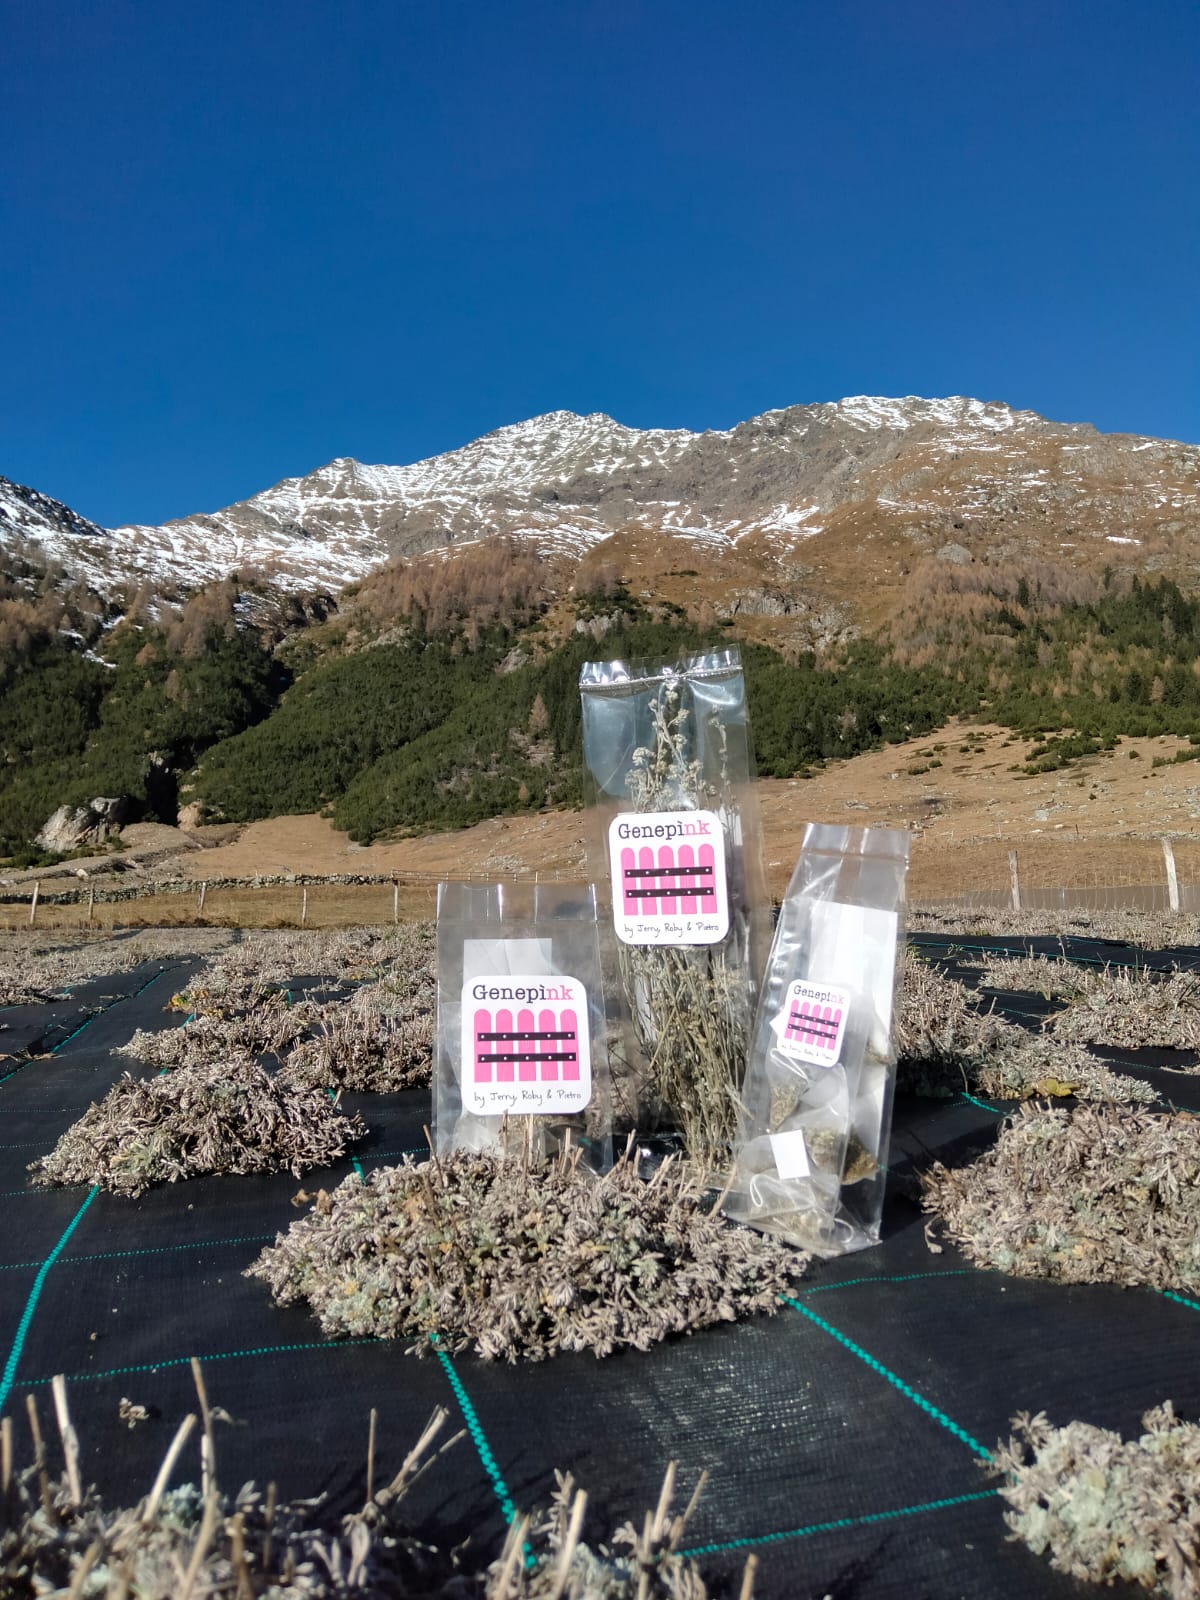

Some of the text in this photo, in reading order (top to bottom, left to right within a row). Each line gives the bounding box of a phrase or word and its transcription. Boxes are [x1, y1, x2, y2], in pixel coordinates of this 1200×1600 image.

[625, 924, 633, 938] by
[665, 922, 683, 937] Roby
[687, 922, 692, 931] &
[474, 1092, 485, 1108] by
[522, 1090, 543, 1105] Roby
[547, 1090, 552, 1099] &
[557, 1089, 581, 1099] Pietro
